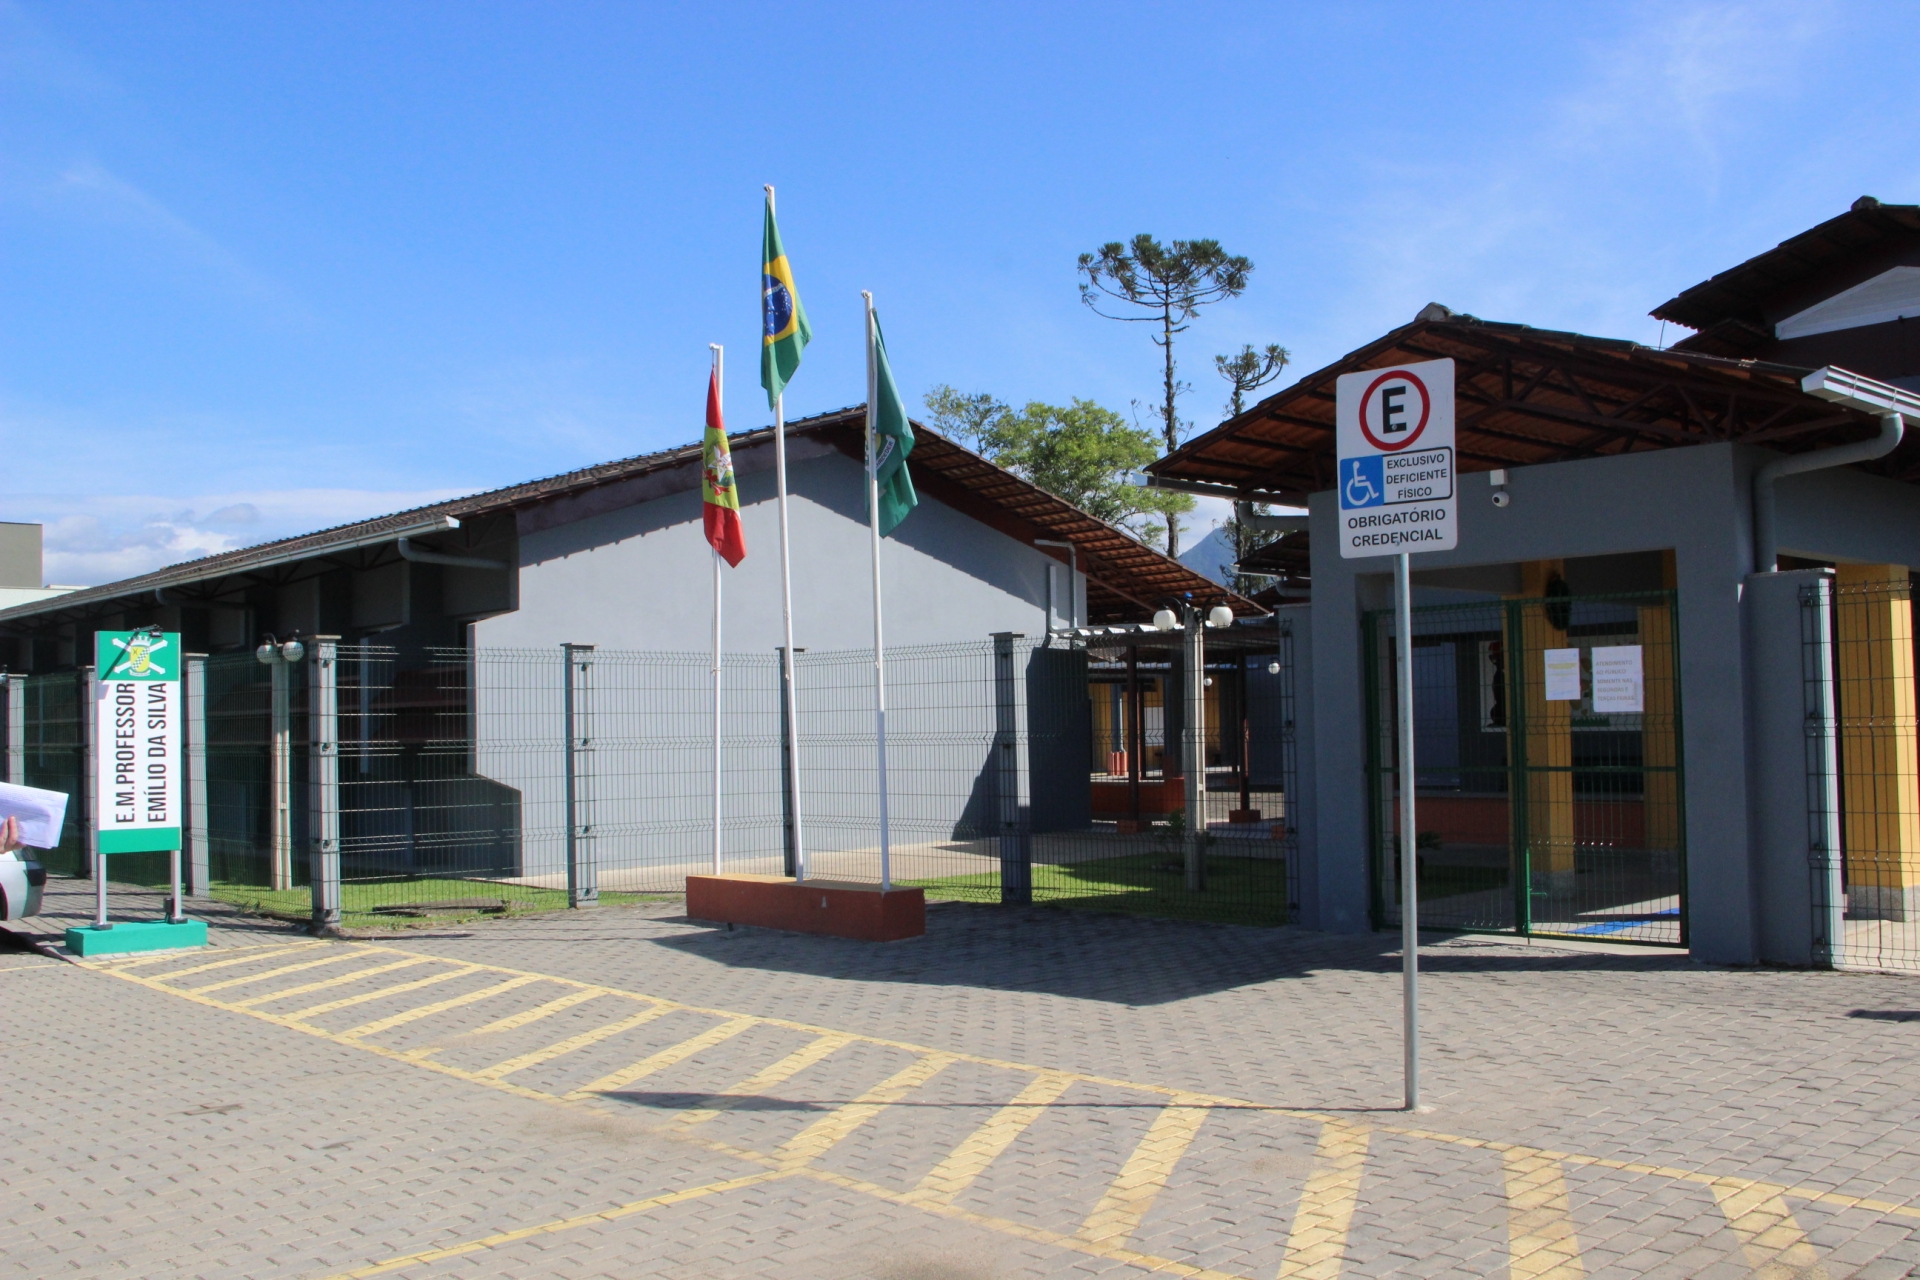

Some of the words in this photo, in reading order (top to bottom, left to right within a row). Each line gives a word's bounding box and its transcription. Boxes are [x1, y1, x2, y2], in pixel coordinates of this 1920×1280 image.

[1382, 386, 1407, 434] E
[1387, 453, 1444, 469] EXCLUSIVO
[1386, 469, 1447, 485] DEFICIENTE
[1398, 486, 1432, 499] FÍSICO
[1348, 507, 1446, 529] OBRIGATÓRIO
[1352, 529, 1443, 547] CREDENCIAL
[147, 683, 167, 729] SILVA
[147, 735, 167, 757] DA
[143, 763, 167, 823] EMÍLIO
